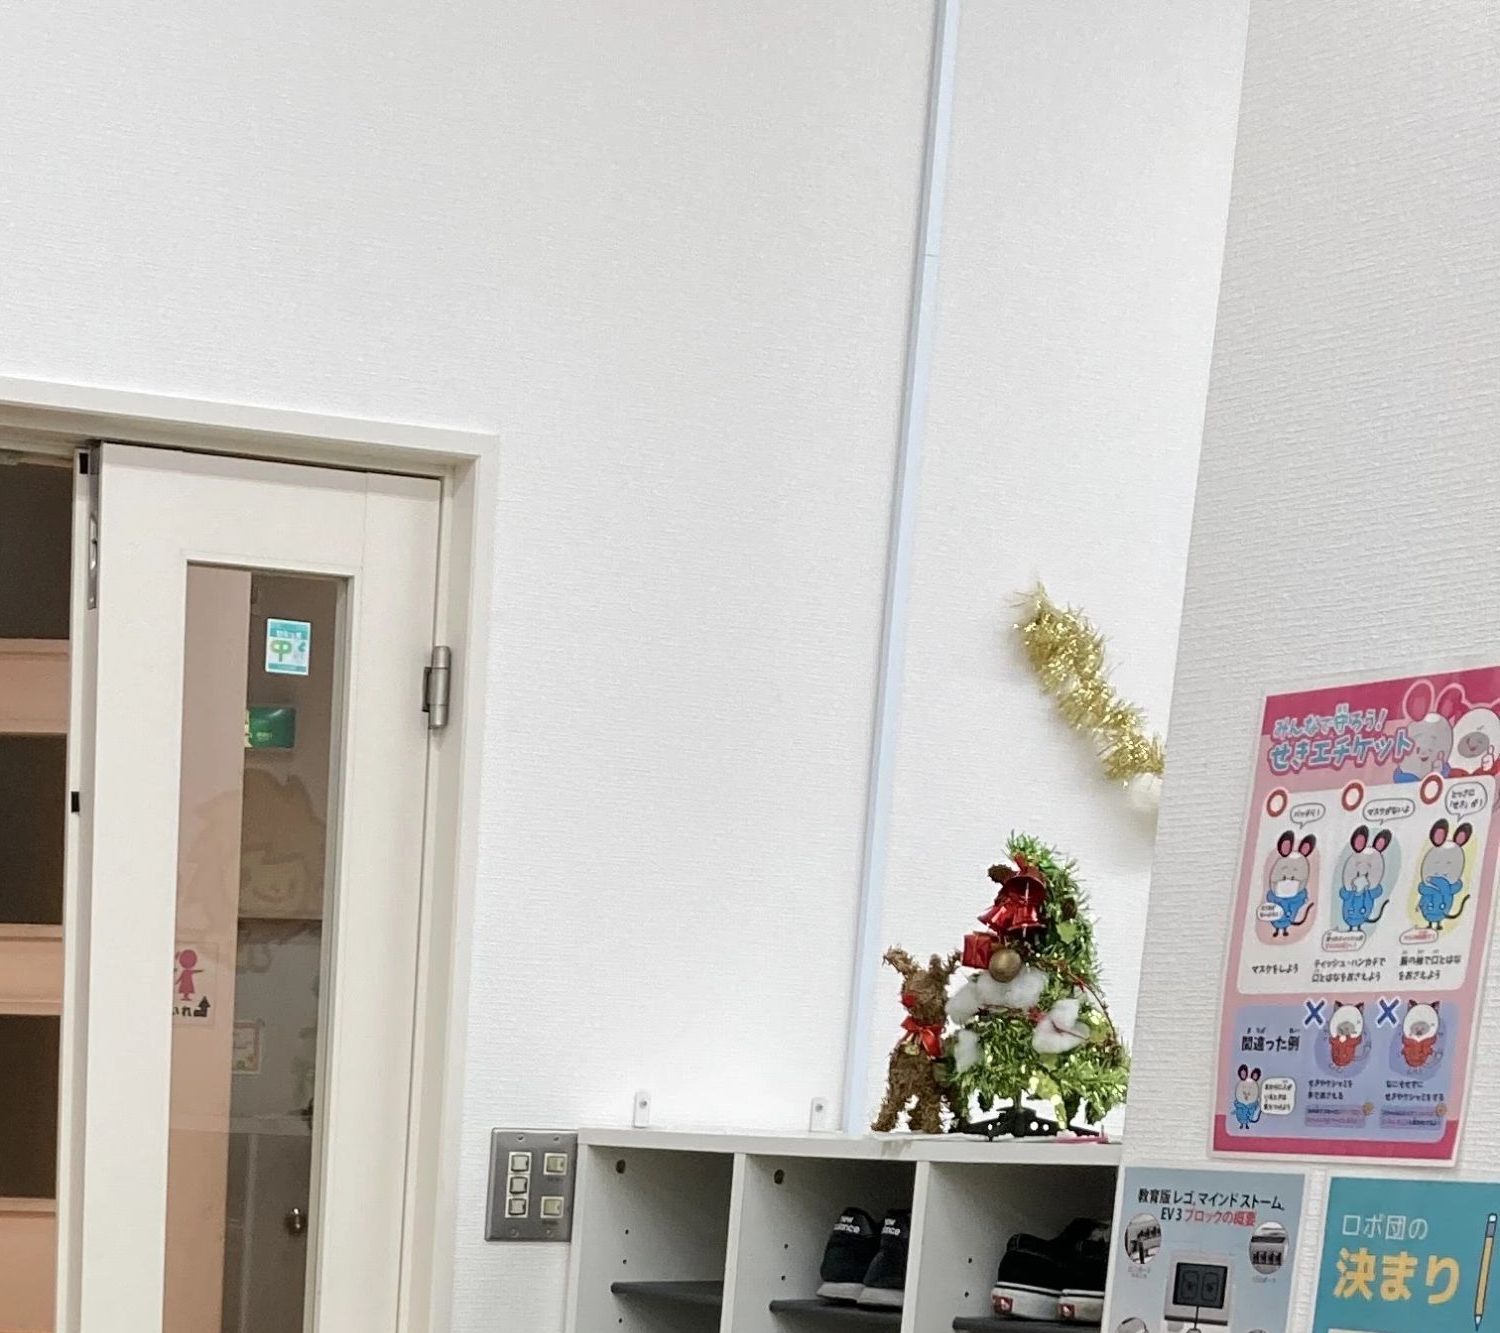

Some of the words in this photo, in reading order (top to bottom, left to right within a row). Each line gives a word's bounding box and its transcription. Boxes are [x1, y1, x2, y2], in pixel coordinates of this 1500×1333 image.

[1271, 728, 1413, 772] せきエチケット
[1252, 964, 1299, 974] マスクをしよう
[1241, 1036, 1300, 1051] 間違った例
[1138, 1188, 1171, 1204] 教育版
[1185, 1209, 1256, 1226] ブロックの概要
[1342, 1214, 1428, 1241] ロボ団の
[1333, 1248, 1460, 1304] 決まり
